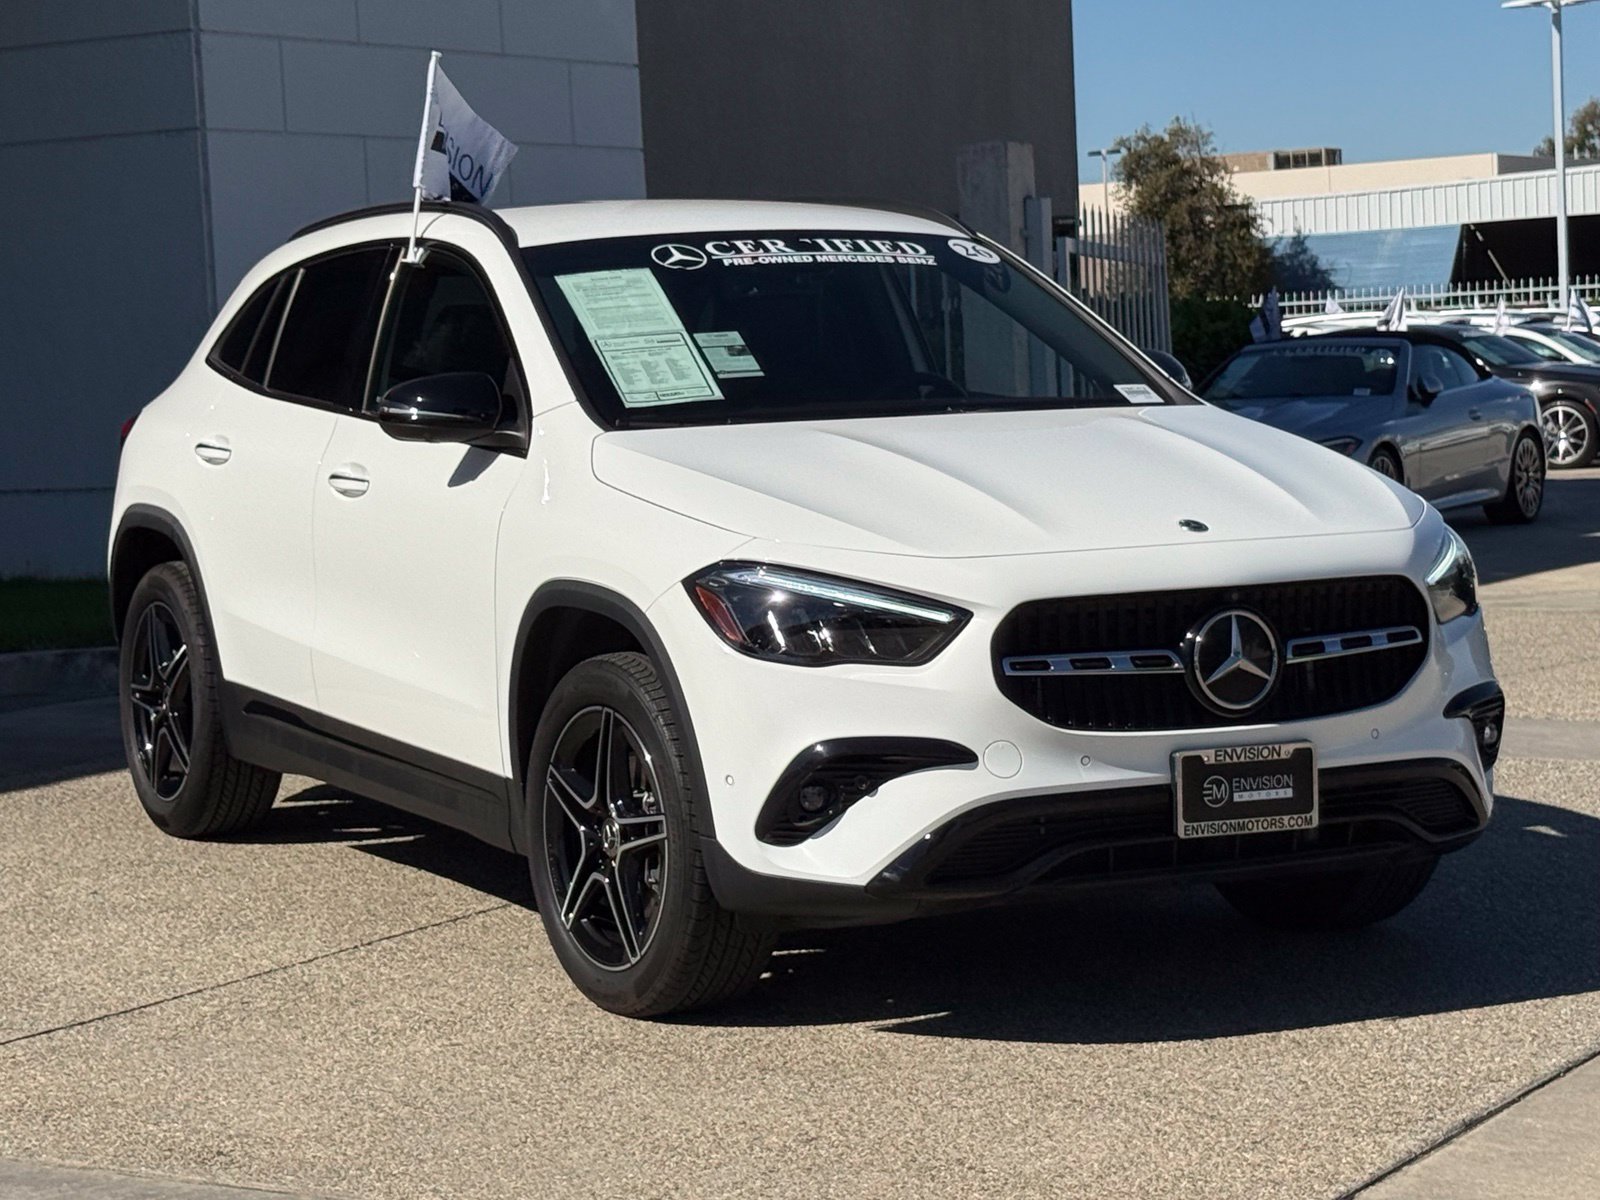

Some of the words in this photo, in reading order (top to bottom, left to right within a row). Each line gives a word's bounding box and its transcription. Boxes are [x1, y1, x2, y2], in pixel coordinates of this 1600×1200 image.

[704, 238, 927, 256] CERIFIED
[722, 255, 814, 267] PRE-OWNED
[814, 254, 896, 264] MERCEDES
[896, 256, 937, 266] BENZ
[1214, 744, 1282, 762] ENVISION
[1232, 774, 1294, 792] ENVISION
[1183, 814, 1314, 837] ENVISIONMOTORS.COM
